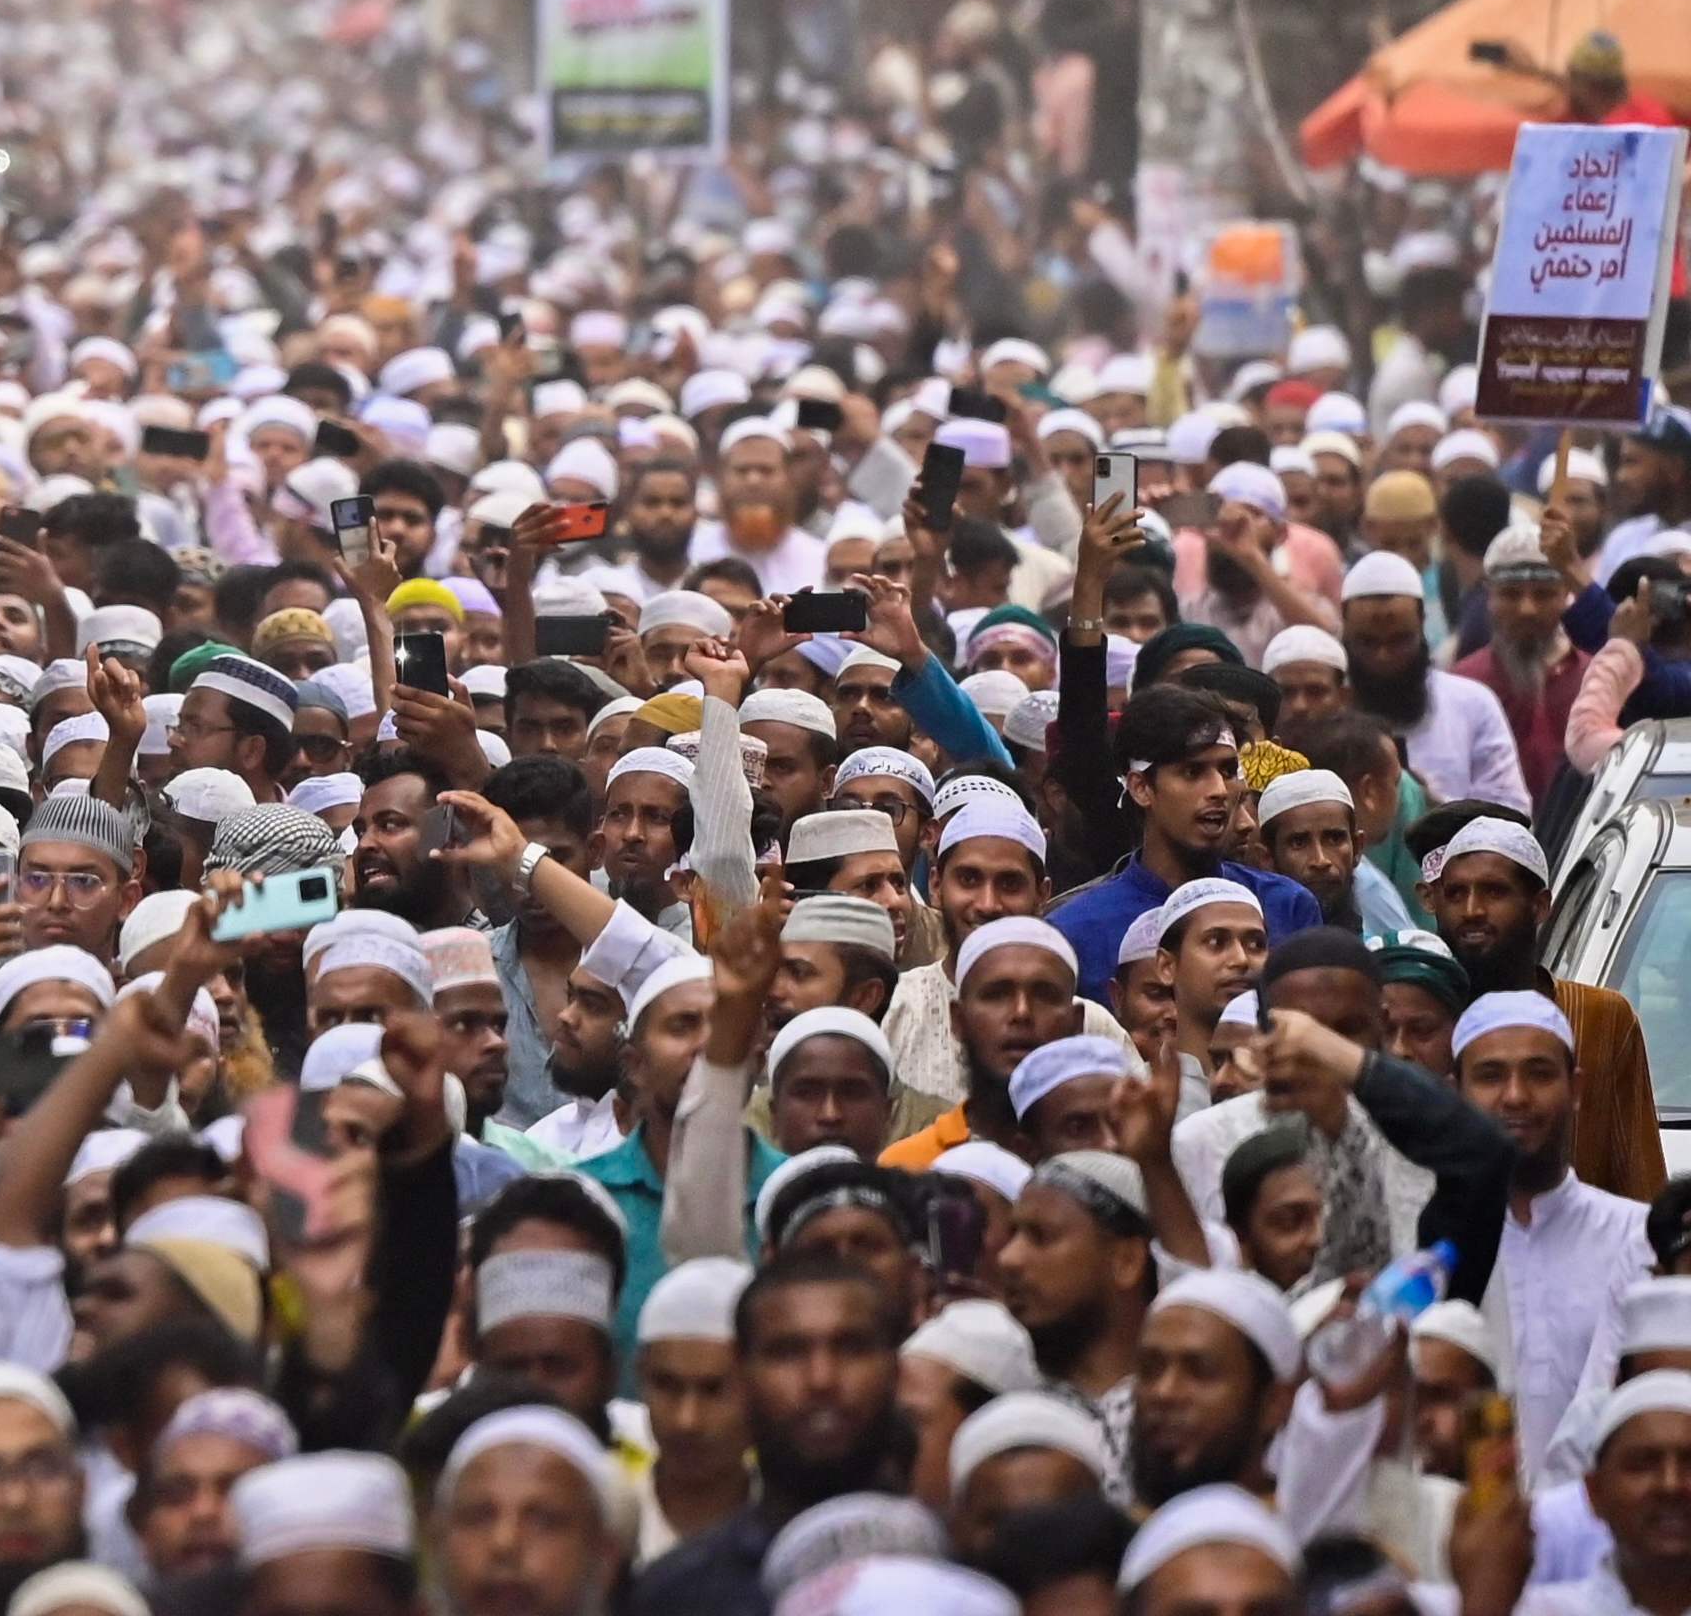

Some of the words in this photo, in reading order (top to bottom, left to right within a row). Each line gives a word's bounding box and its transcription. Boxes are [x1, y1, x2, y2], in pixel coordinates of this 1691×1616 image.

[1561, 183, 1617, 221] زعماء
[1533, 217, 1633, 253] المسلمين
[1530, 253, 1593, 294] حتمي
